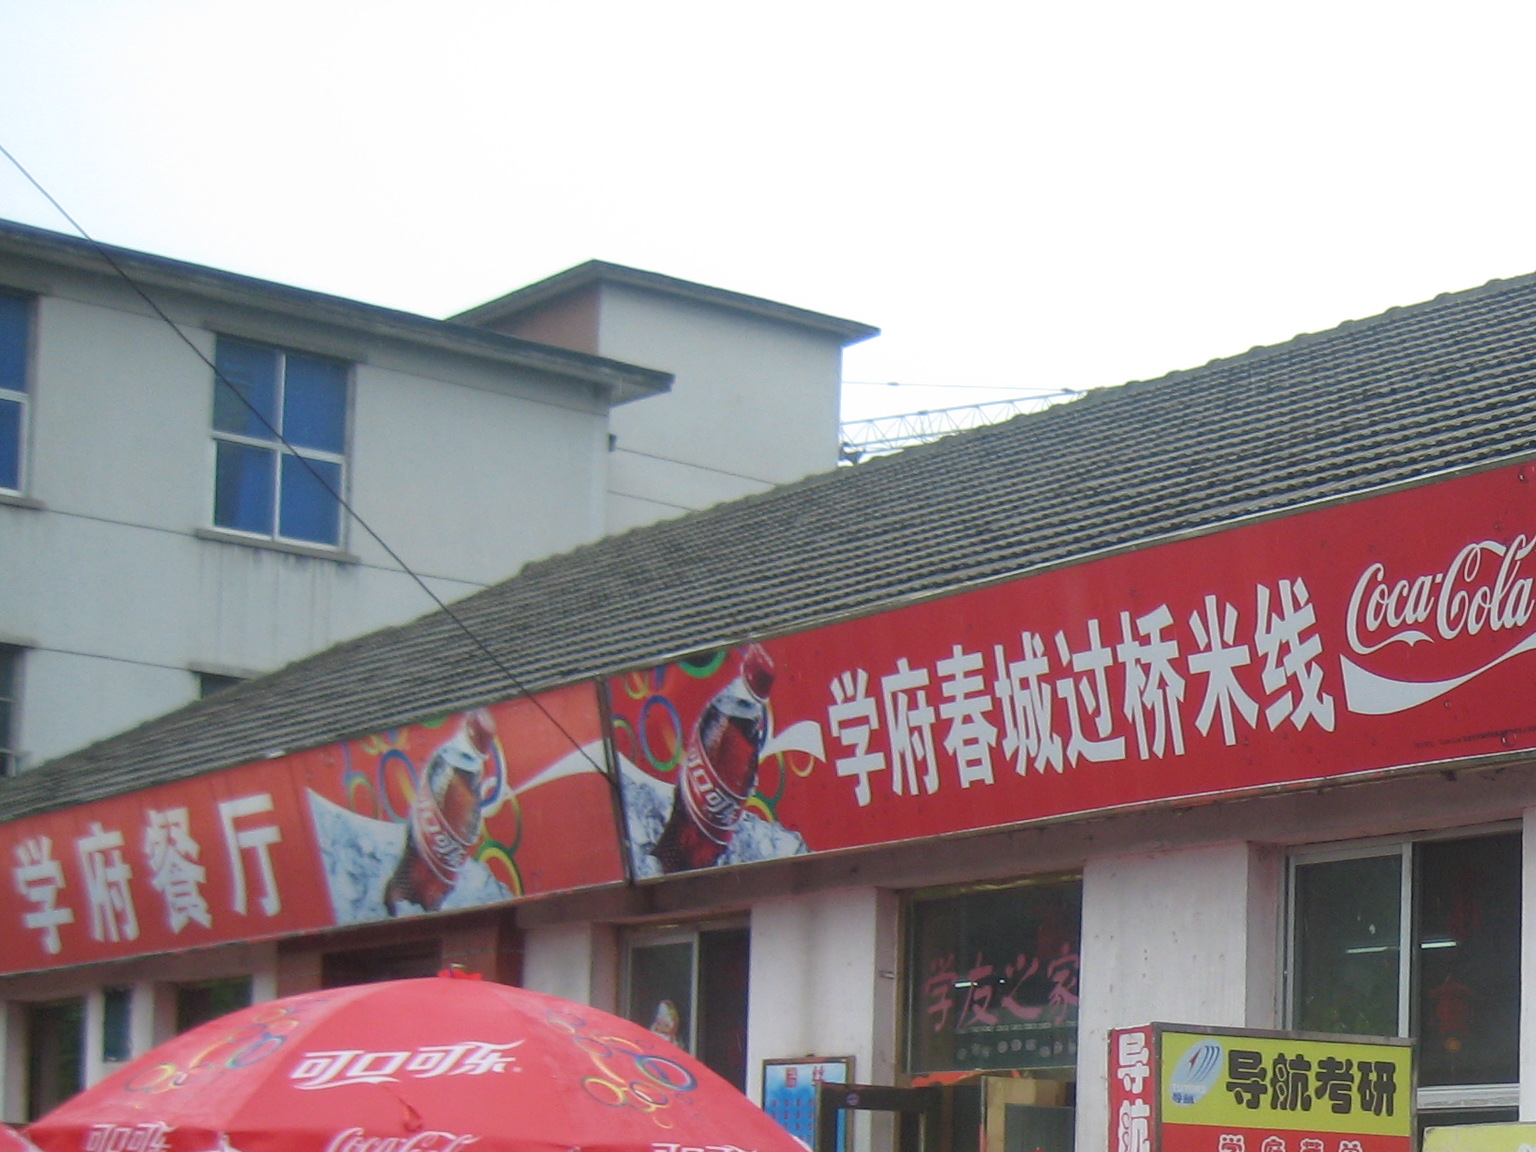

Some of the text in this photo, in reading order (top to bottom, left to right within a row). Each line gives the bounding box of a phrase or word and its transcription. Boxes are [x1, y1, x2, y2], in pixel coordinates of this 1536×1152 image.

[828, 577, 1336, 808] 学府春城过桥米线
[12, 791, 284, 957] 学府餐厅
[925, 943, 1078, 1031] 学友之家
[291, 1039, 526, 1090] 可口可乐
[1226, 1049, 1397, 1117] 导航考研
